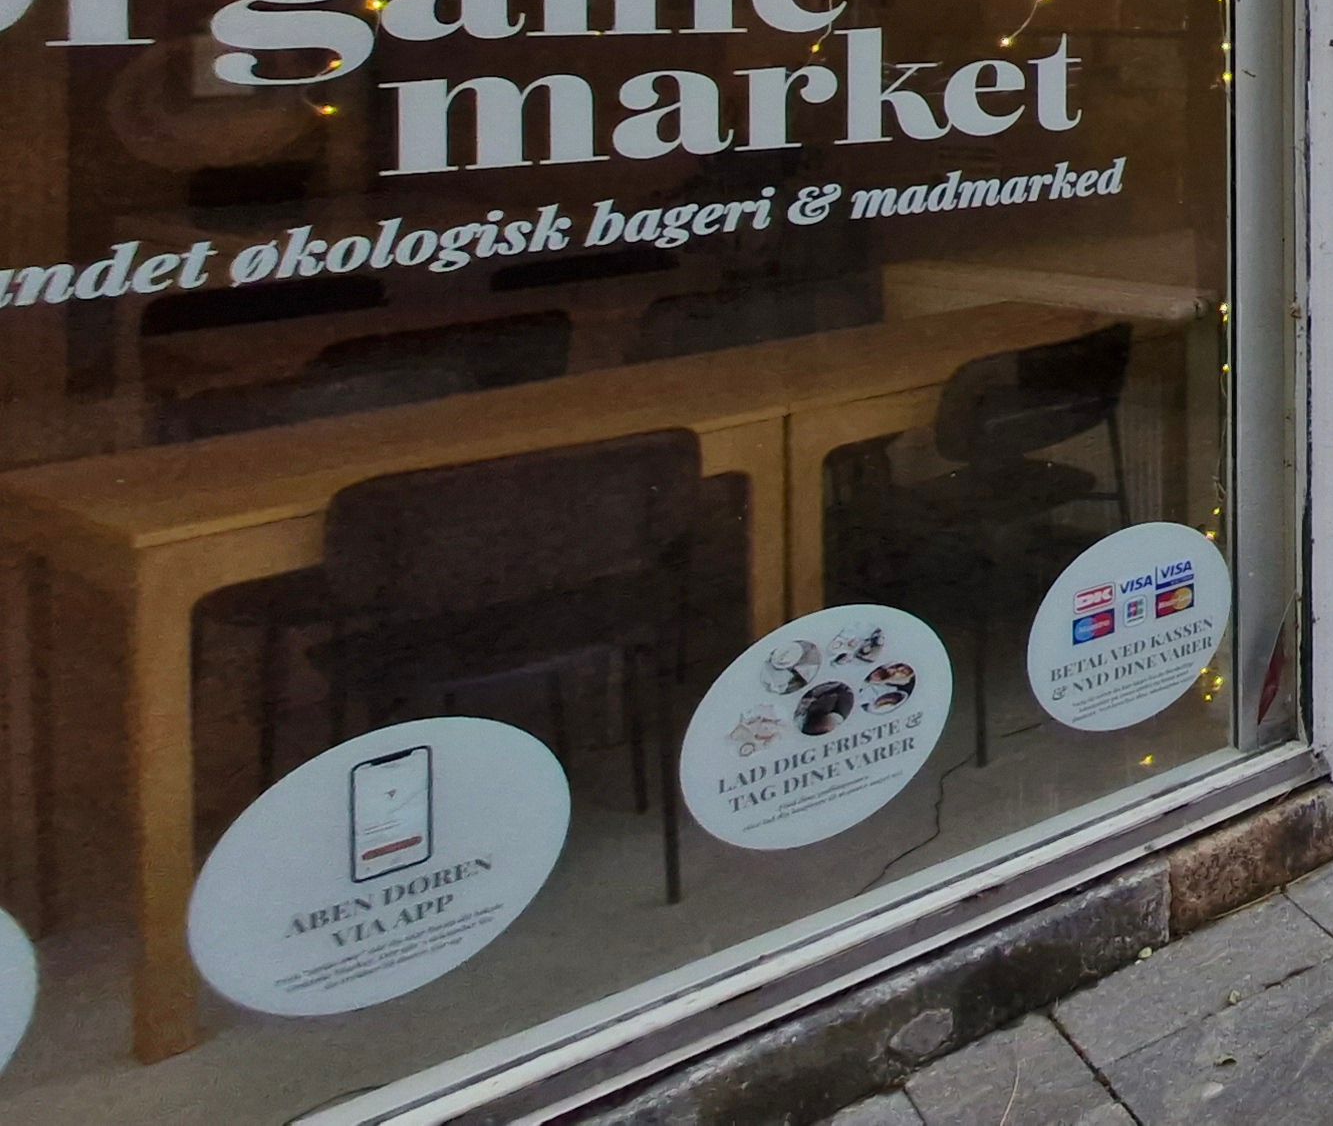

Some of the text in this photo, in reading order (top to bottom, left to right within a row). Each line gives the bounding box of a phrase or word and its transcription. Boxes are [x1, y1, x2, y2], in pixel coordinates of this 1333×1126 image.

[379, 27, 1082, 176] market
[230, 204, 572, 287] økologisk
[585, 185, 776, 249] bageri
[787, 183, 842, 225] &
[849, 156, 1127, 219] madmarked
[1120, 575, 1152, 594] VISA
[1161, 560, 1193, 579] VISA
[1051, 616, 1213, 682] BETAL VED KASSEN
[1052, 636, 1213, 701] & NYD DINE VARER
[718, 711, 923, 794] LAD DIG FRISTE &
[728, 784, 777, 813] TAG
[783, 762, 840, 795] DINE
[844, 736, 915, 772] VARER
[332, 894, 454, 947] VIA APP
